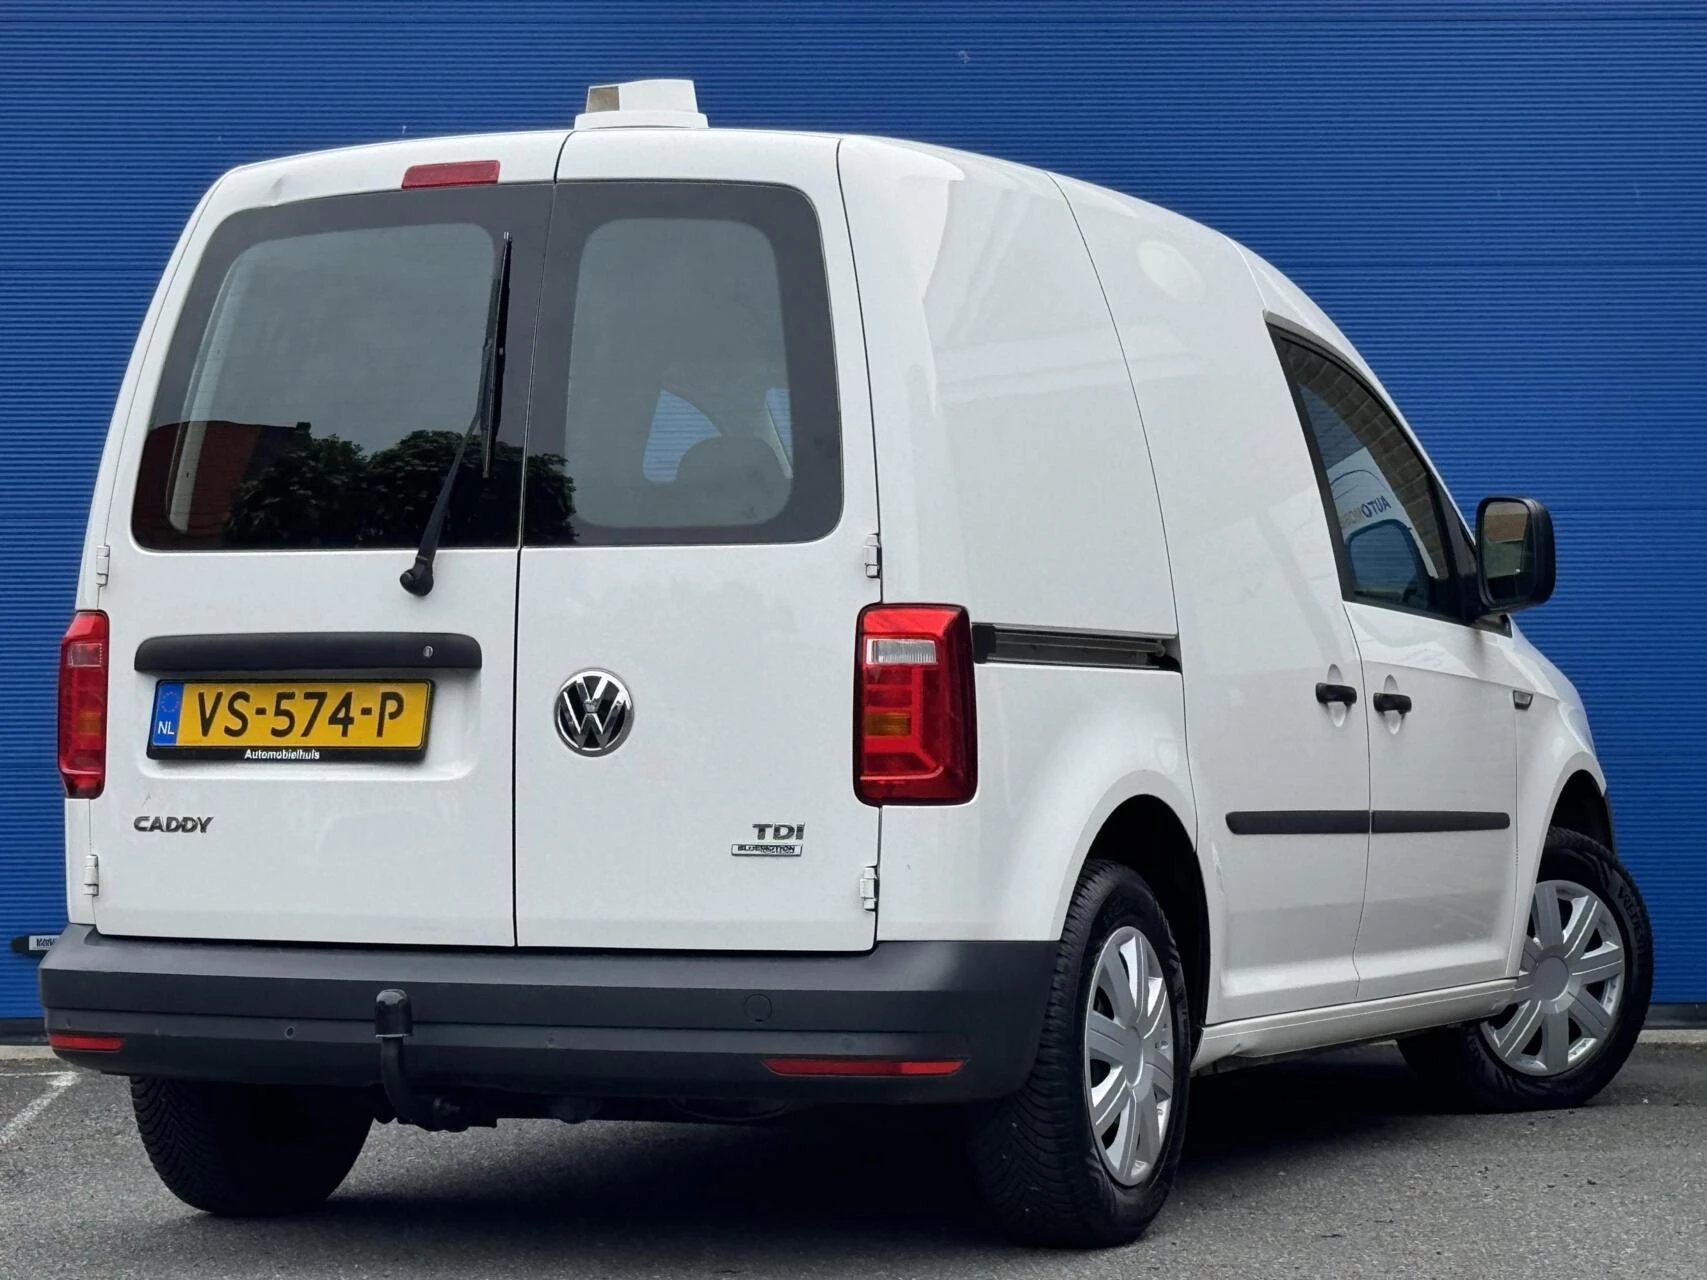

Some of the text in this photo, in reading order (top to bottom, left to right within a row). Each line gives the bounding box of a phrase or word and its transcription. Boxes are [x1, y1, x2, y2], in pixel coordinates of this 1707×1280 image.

[197, 691, 405, 738] VS-574-P
[157, 721, 175, 735] NL
[244, 748, 320, 760] Automobielhuis
[133, 815, 215, 834] CADDY
[752, 823, 805, 840] TDI
